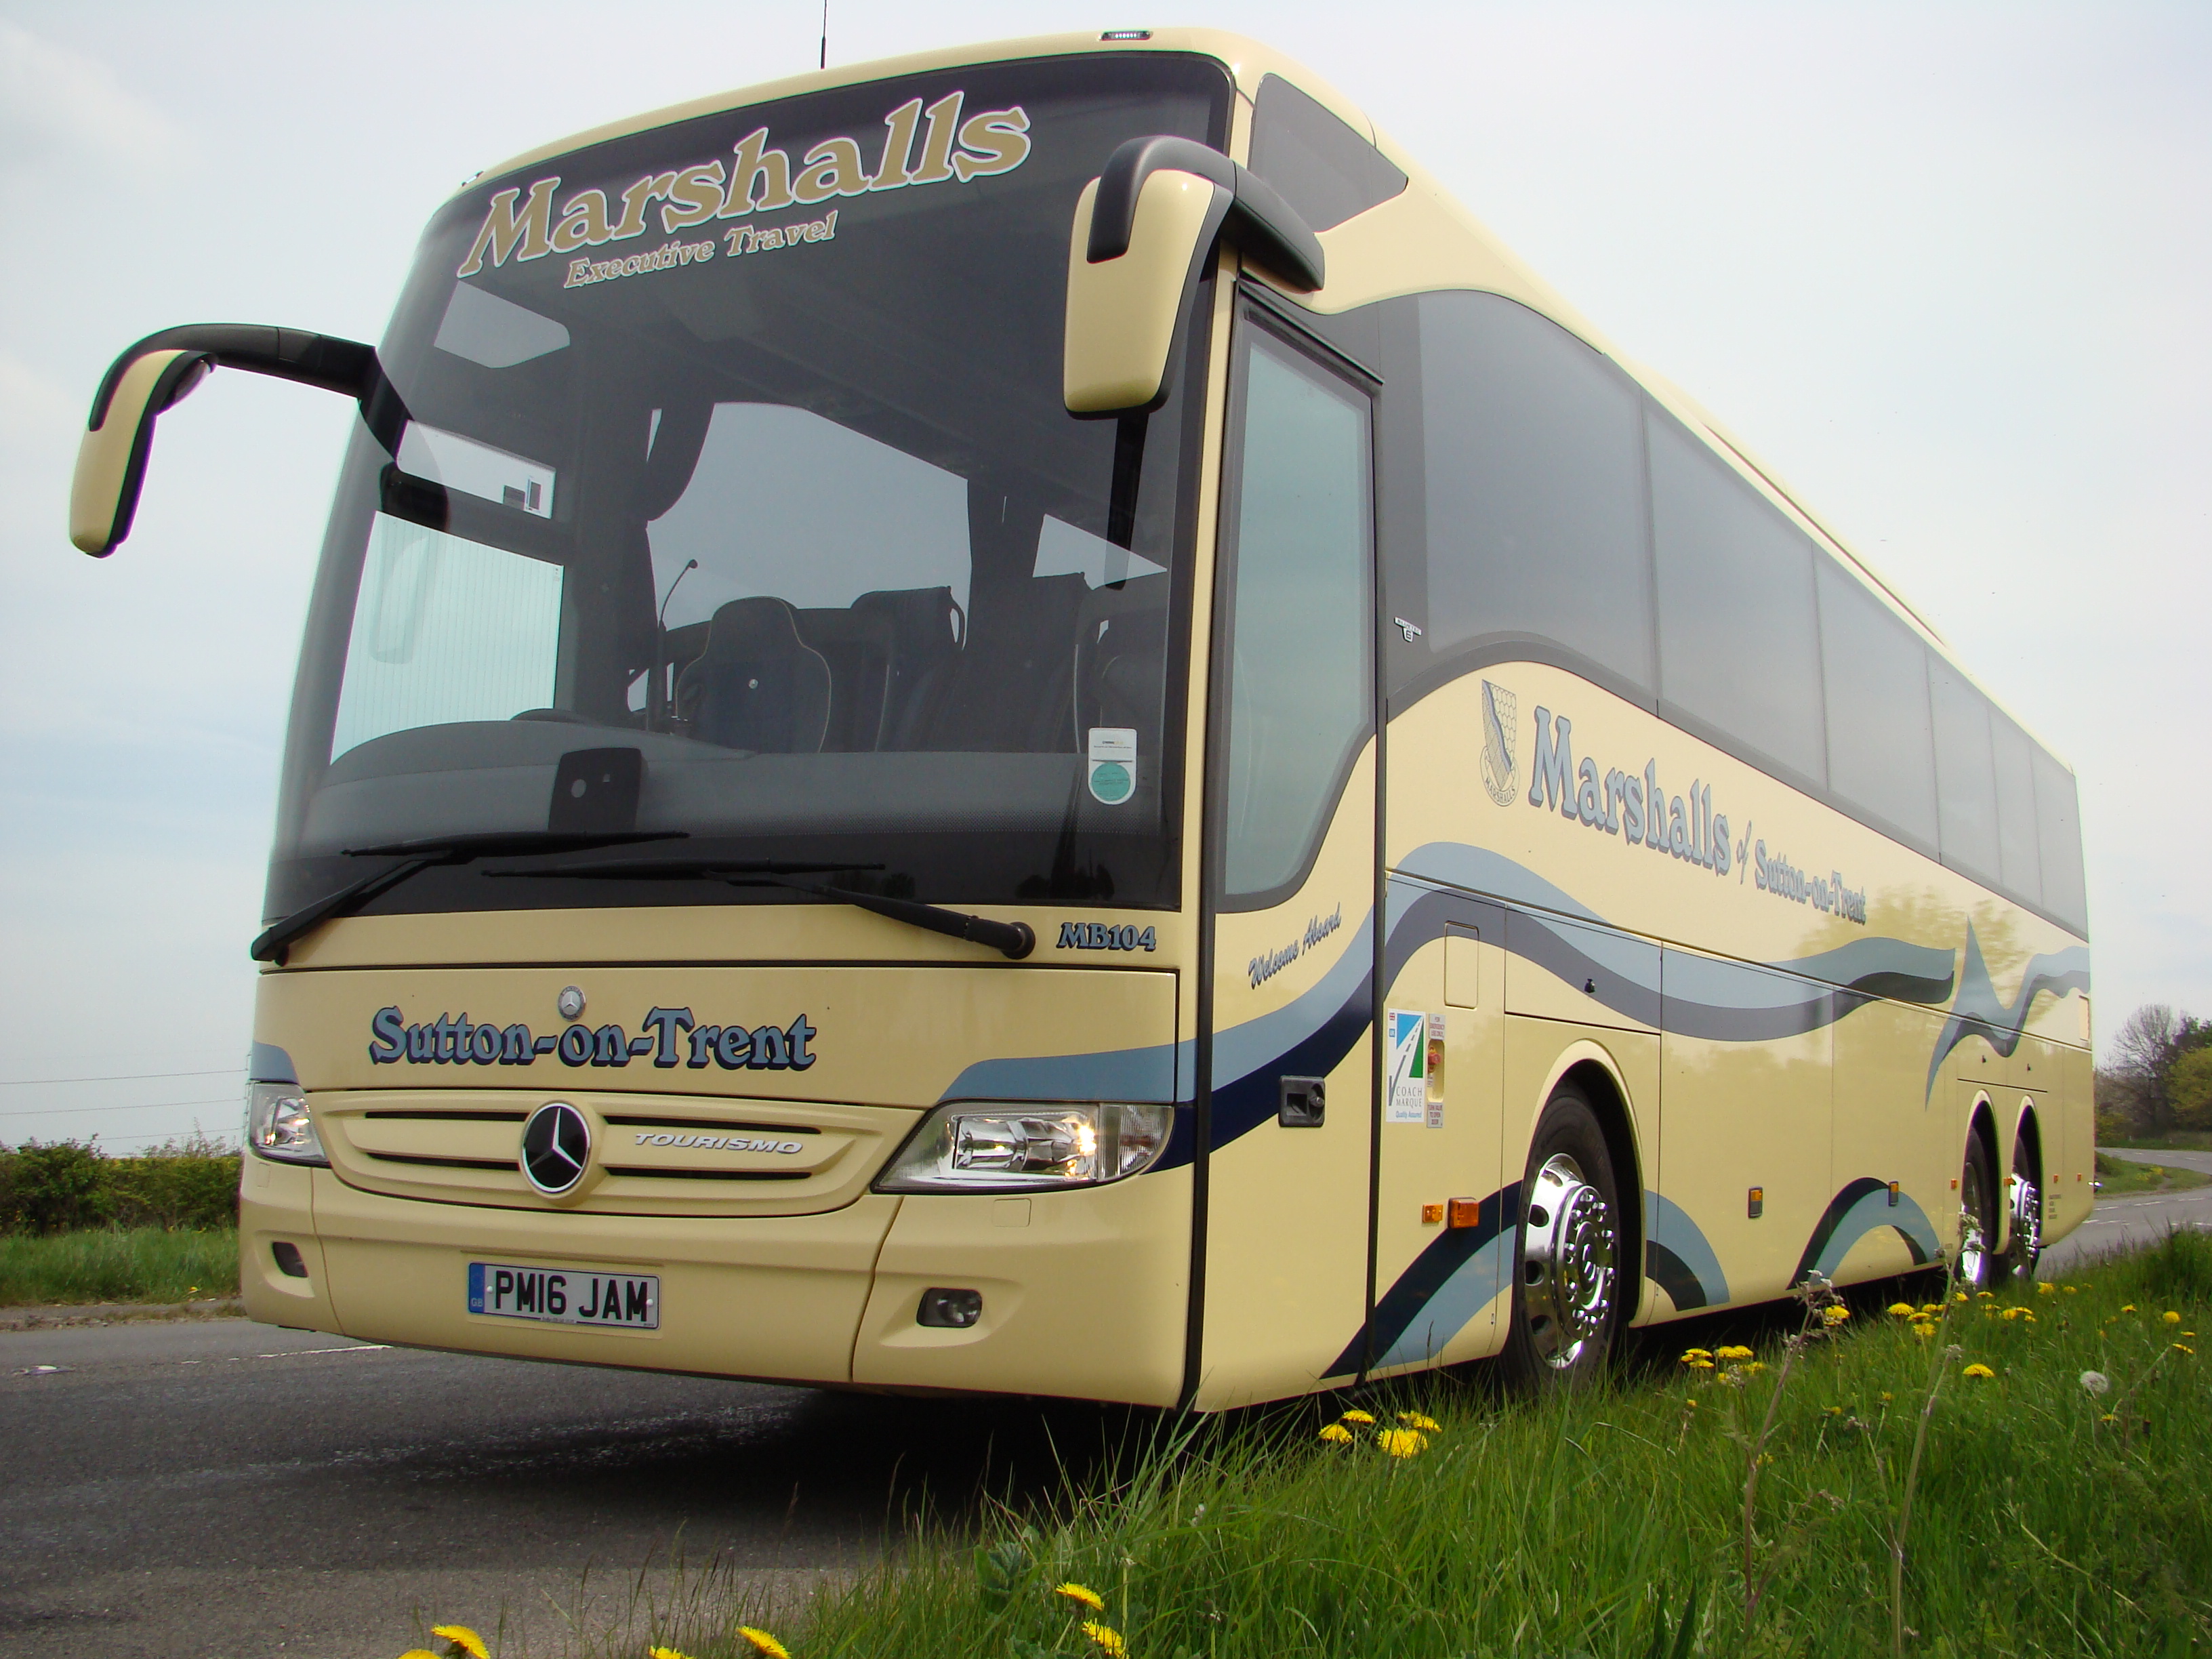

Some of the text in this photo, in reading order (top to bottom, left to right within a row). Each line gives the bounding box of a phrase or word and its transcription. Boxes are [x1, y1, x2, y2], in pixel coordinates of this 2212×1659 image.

[457, 90, 1031, 279] Marshalls
[564, 211, 838, 289] Executive Travel
[1485, 777, 1515, 804] MARSHALLS
[1528, 705, 1866, 926] Marshalls of Sutton-on-Trent
[1056, 922, 1157, 951] MB104
[1248, 901, 1342, 990] Welcome Aboard
[369, 1006, 817, 1071] Sutton-on-Trent
[1396, 1086, 1422, 1097] COACH
[1396, 1098, 1422, 1109] MARQUE
[635, 1133, 803, 1153] TOURISMO
[470, 1297, 483, 1307] GB
[496, 1270, 648, 1322] PM16 JAM
